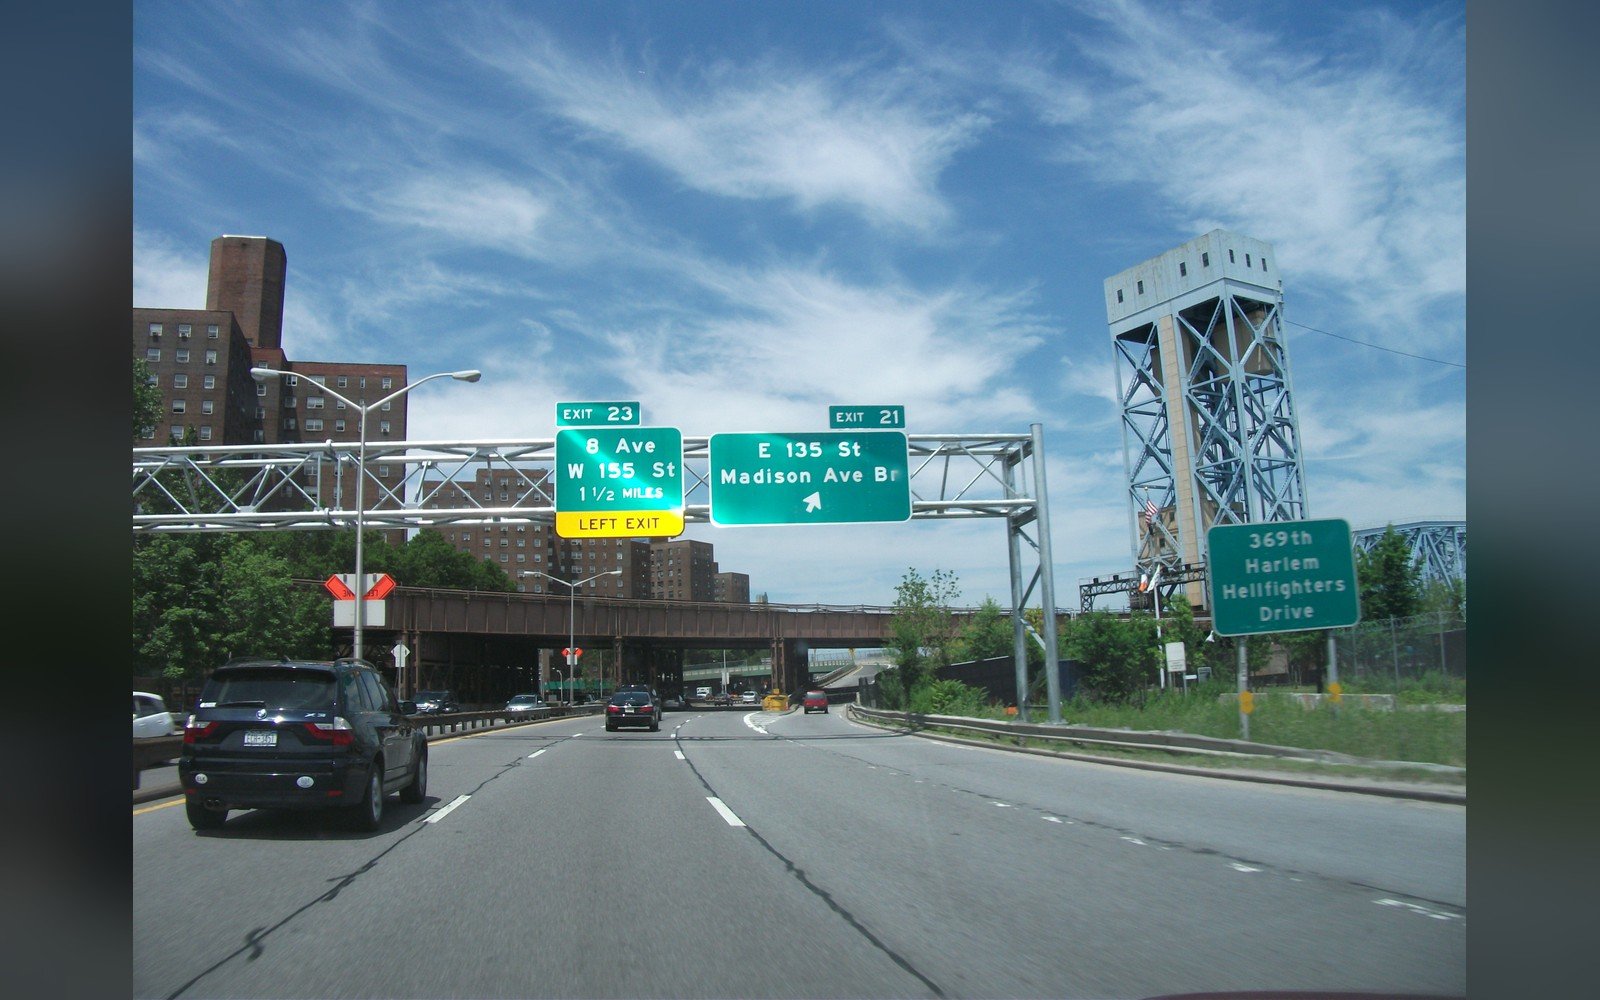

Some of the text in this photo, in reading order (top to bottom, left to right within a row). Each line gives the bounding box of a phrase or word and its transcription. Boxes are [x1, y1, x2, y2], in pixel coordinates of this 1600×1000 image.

[563, 406, 633, 421] EXIT 23
[836, 409, 899, 424] EXIT 21
[585, 437, 656, 455] 8 Ave
[758, 441, 861, 458] E 135 St
[567, 461, 676, 479] W 155 St
[720, 466, 900, 485] Madison Ave Br
[622, 487, 664, 499] MILES
[579, 517, 660, 530] LEFT EXIT
[1248, 530, 1313, 549] 369th
[1245, 556, 1320, 574] Harlem
[1222, 578, 1347, 600] Hellfighters
[1259, 604, 1315, 622] Drive
